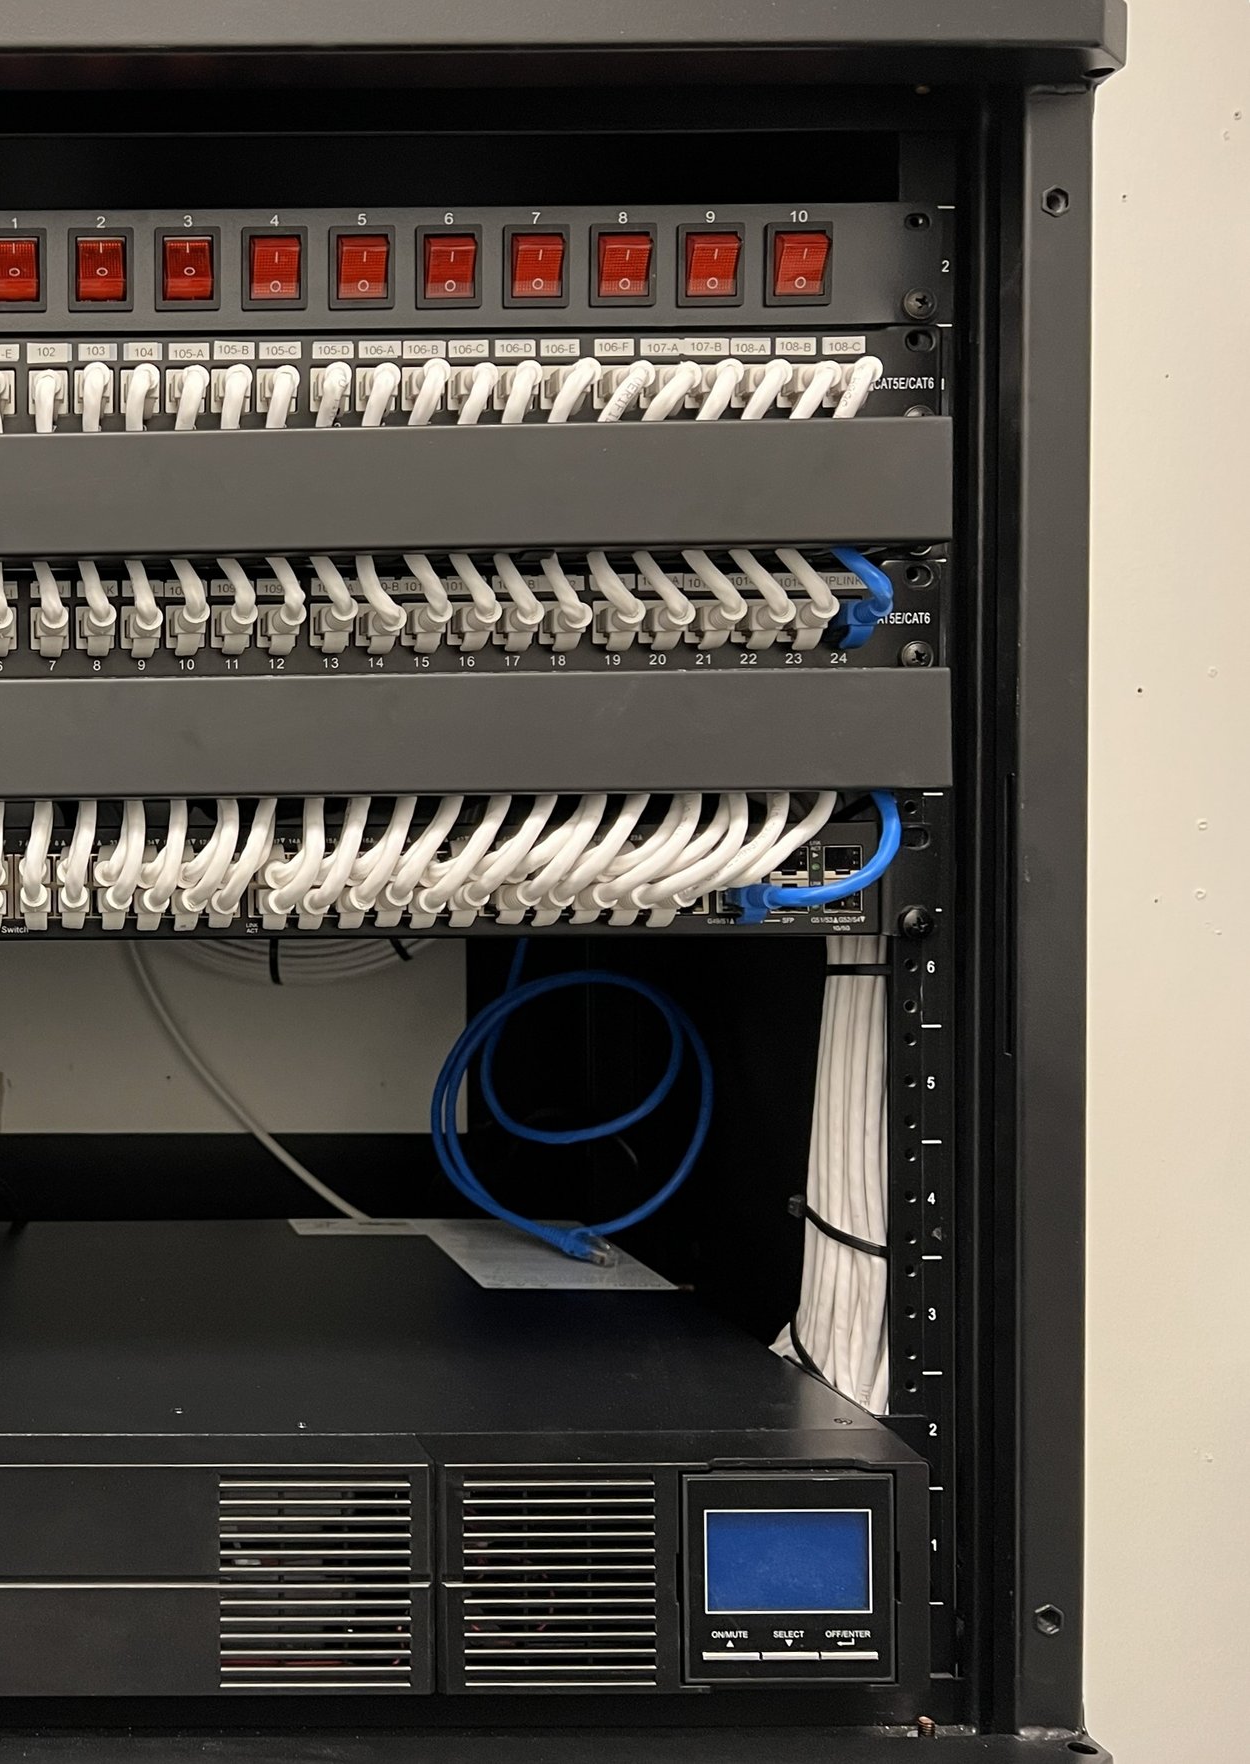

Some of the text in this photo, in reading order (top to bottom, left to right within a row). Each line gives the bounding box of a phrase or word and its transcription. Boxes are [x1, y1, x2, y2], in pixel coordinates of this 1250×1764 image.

[11, 210, 809, 229] 1 2 3 4 5 6 7 8 9 10
[37, 346, 56, 357] 102
[86, 345, 106, 356] 103
[219, 344, 249, 355] 105-B
[266, 345, 297, 356] 105-C
[318, 345, 350, 356] 105-D
[364, 345, 395, 356] 106-A
[408, 344, 439, 355] 106-B
[453, 343, 485, 355] 106-C
[500, 342, 533, 354] 106-D
[545, 343, 576, 354] 106-E
[599, 341, 629, 352] 106-F
[647, 343, 679, 353] 107-A
[690, 341, 722, 352] 107-B
[735, 343, 767, 353] 108-A
[780, 341, 812, 352] 108-B
[829, 341, 861, 352] 108-C
[135, 347, 153, 358] 104
[173, 348, 205, 359] 105-A
[874, 377, 935, 390] CAT5E/CAT6
[48, 660, 57, 672] 7
[92, 659, 102, 672] 8
[137, 659, 146, 671] 9
[179, 659, 196, 671] 10
[225, 658, 240, 670] 11
[268, 658, 285, 670] 12
[322, 657, 340, 669] 13
[368, 657, 385, 668] 14
[413, 656, 431, 668] 15
[459, 655, 476, 667] 16
[504, 655, 521, 667] 17
[550, 654, 567, 666] 18
[604, 654, 622, 666] 19
[649, 653, 667, 666] 20
[695, 653, 712, 665] 21
[739, 653, 758, 665] 22
[785, 652, 803, 664] 23
[830, 652, 848, 664] 24
[926, 960, 936, 974] 6
[926, 1076, 936, 1090] 5
[926, 1192, 936, 1206] 4
[927, 1307, 937, 1321] 3
[928, 1422, 938, 1437] 2
[930, 1538, 937, 1552] 1
[711, 1630, 871, 1639] ON/MUTE SELECT OFF/ENTER
